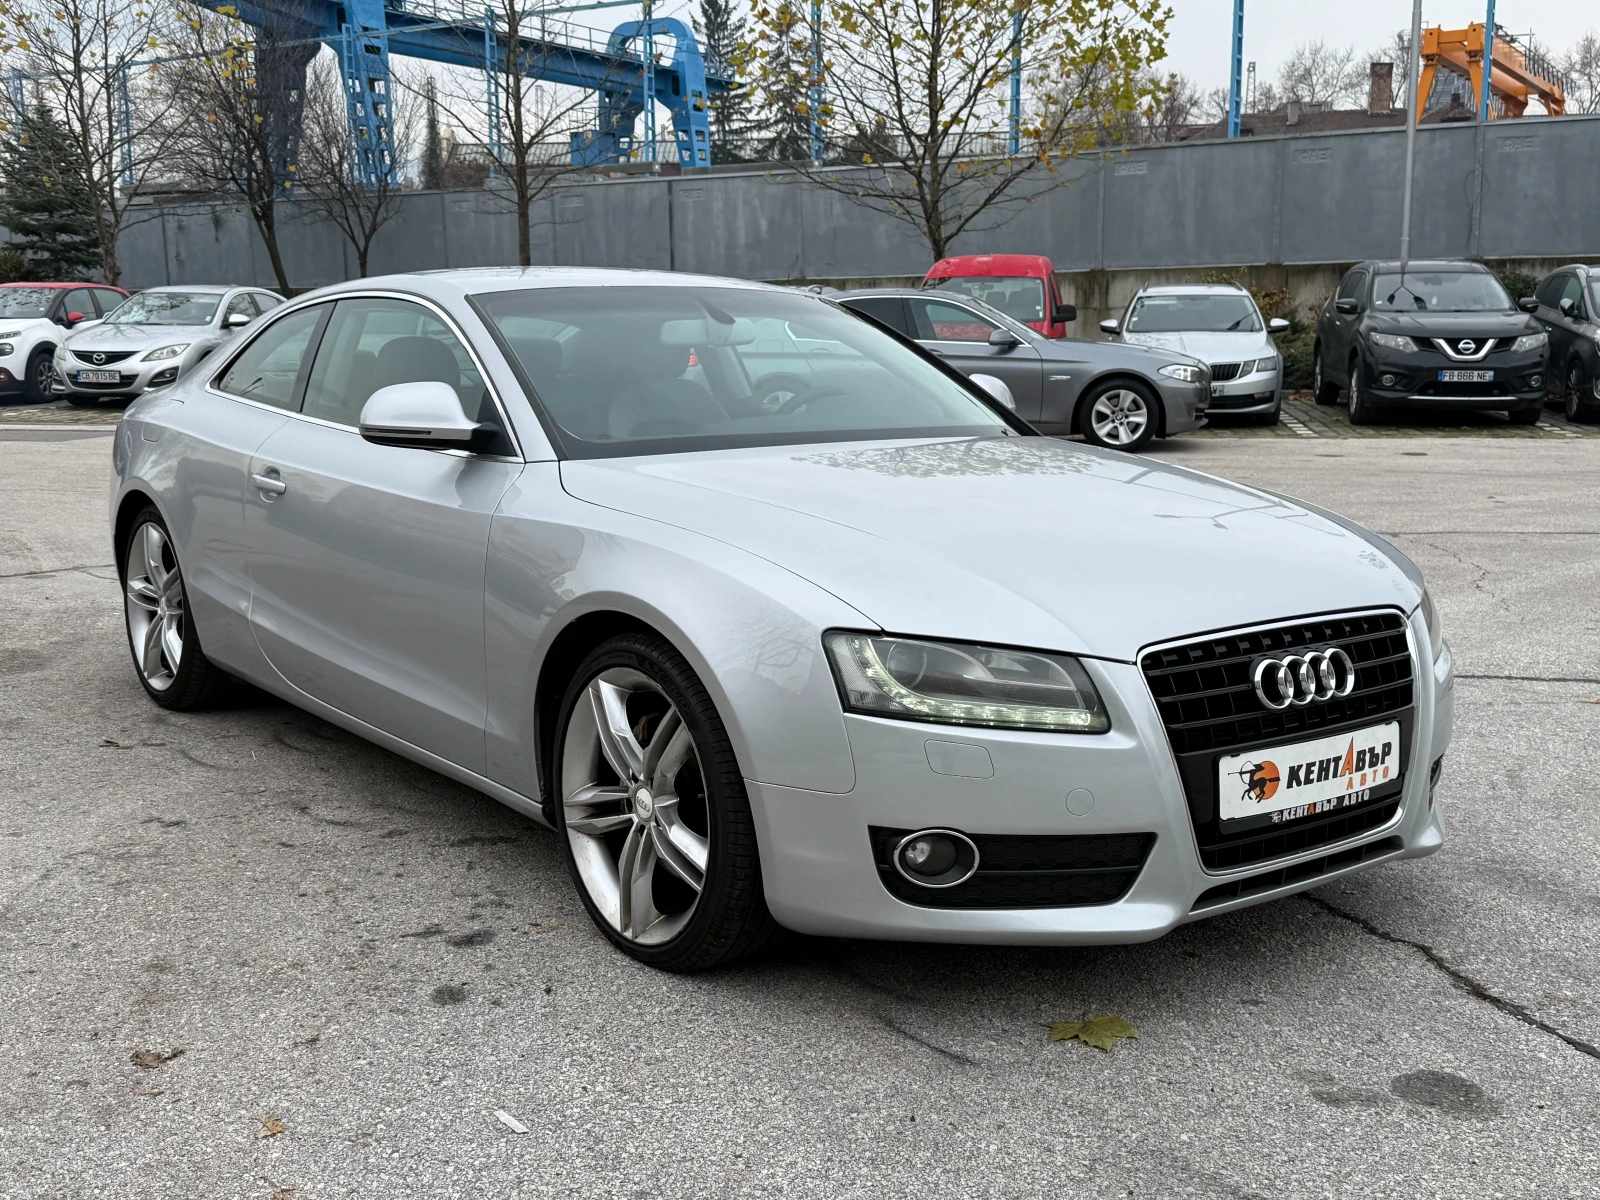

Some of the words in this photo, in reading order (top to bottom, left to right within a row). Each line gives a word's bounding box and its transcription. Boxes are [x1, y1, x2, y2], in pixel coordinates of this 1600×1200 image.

[1286, 736, 1392, 789] КЕНТАВЪР
[1346, 766, 1390, 791] АВТО
[1282, 796, 1337, 821] КЕНТАВЪР
[1343, 789, 1370, 806] АВТО
